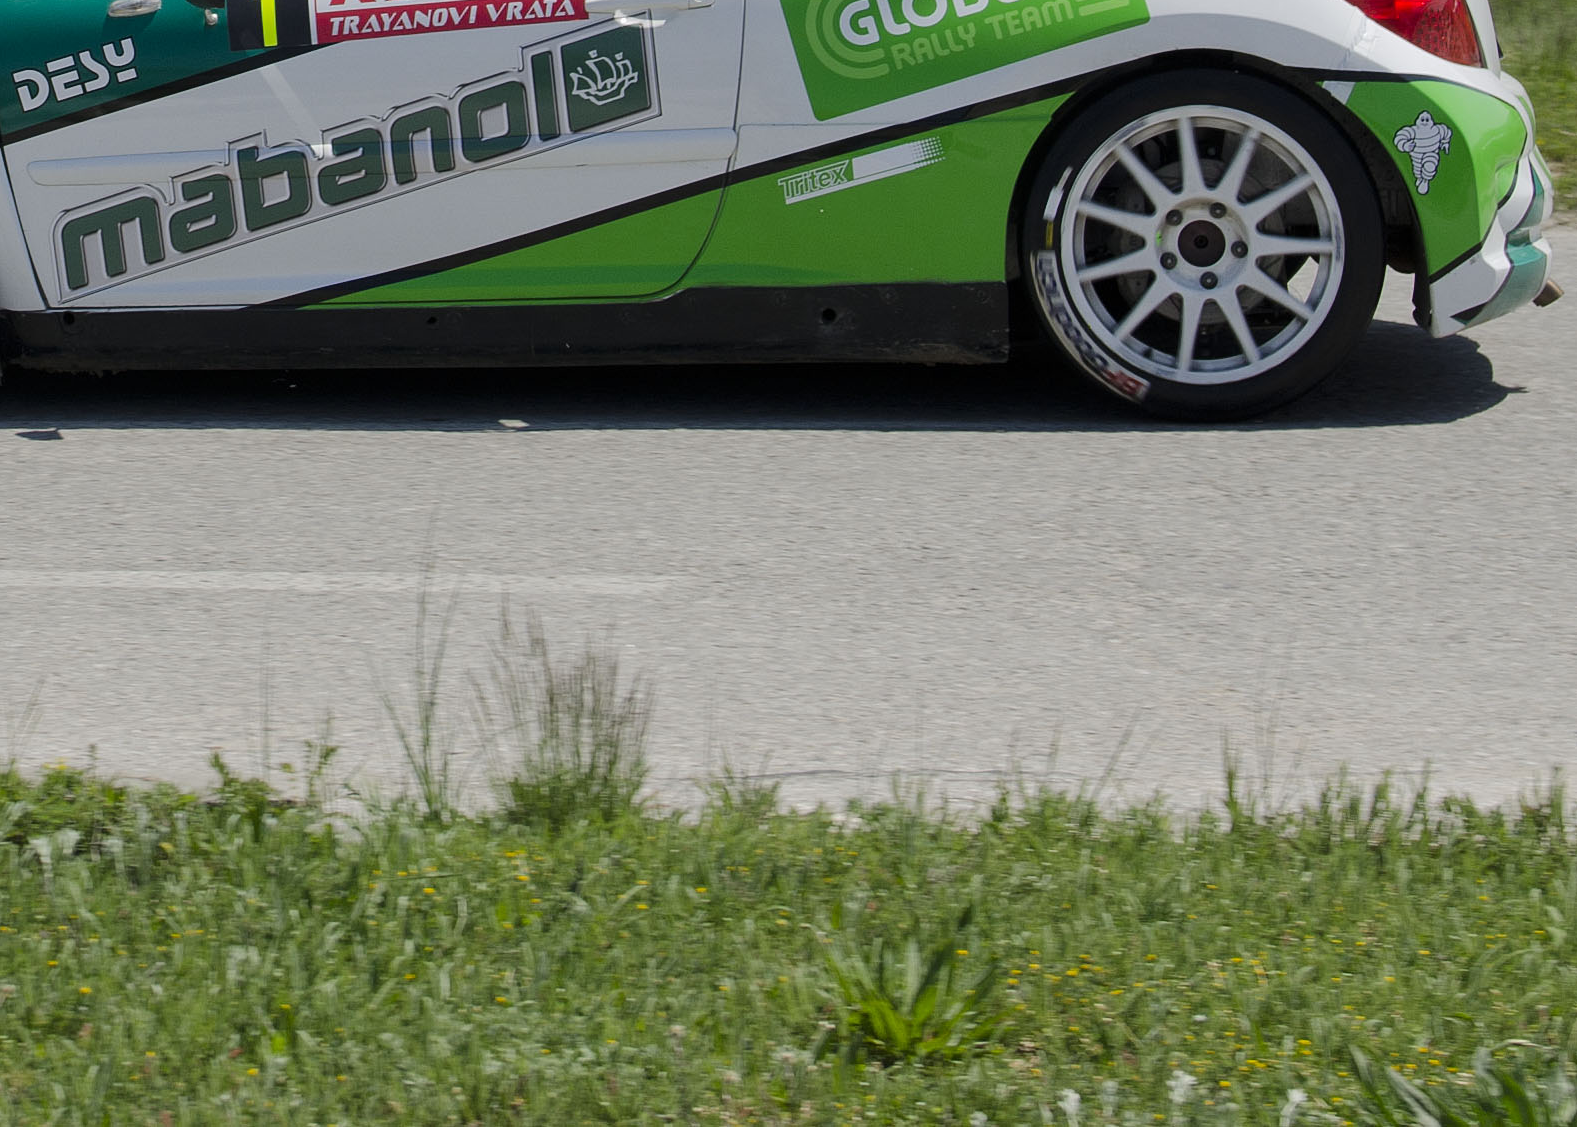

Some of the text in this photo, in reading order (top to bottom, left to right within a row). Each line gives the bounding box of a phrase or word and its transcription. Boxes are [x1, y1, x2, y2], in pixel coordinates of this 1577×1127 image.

[330, 4, 479, 37] TRAYANOVI
[890, 22, 977, 70] RALLY
[12, 37, 138, 113] DESY
[59, 49, 562, 292] mabanol
[777, 159, 850, 200] Tritex
